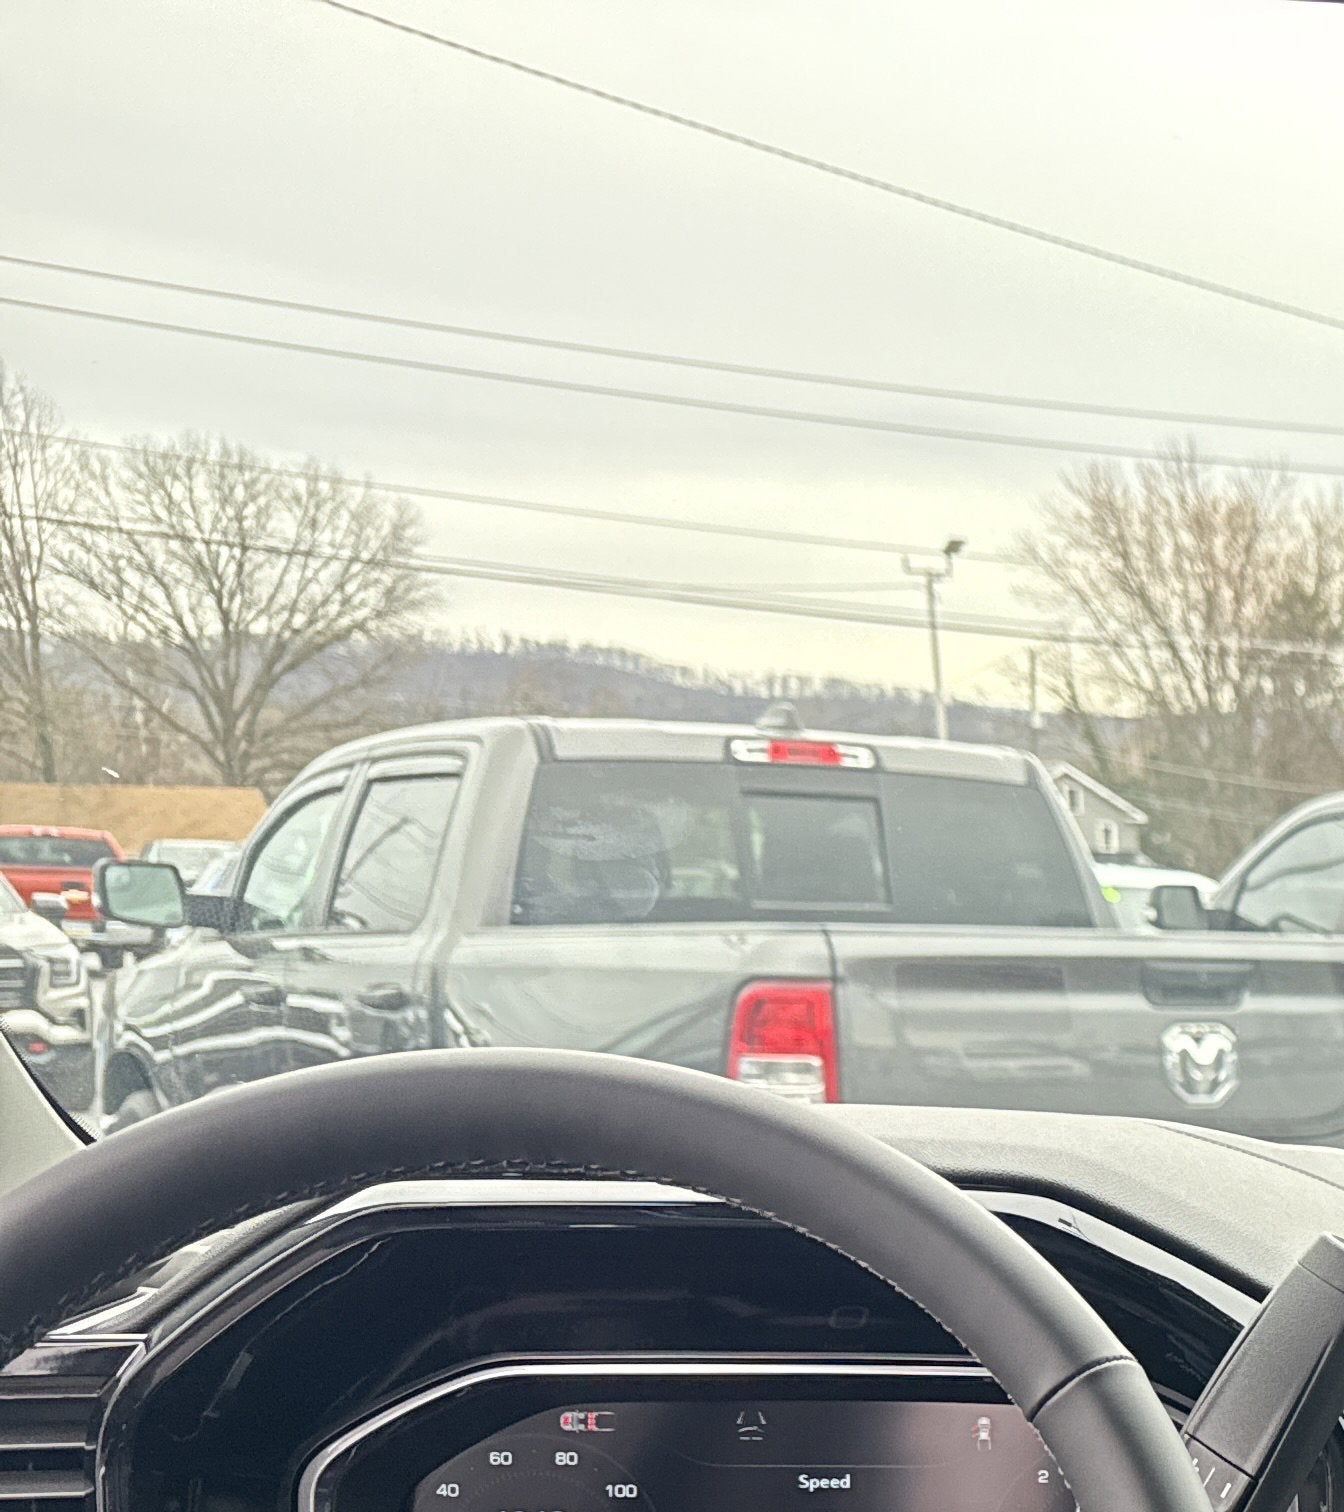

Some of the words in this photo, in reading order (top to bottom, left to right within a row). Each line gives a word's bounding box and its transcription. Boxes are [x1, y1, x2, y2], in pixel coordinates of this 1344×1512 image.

[489, 1451, 513, 1466] 60
[555, 1451, 579, 1466] 80
[798, 1473, 851, 1492] Speed
[1036, 1470, 1049, 1484] 2
[436, 1483, 460, 1498] 40
[605, 1484, 638, 1498] 100
